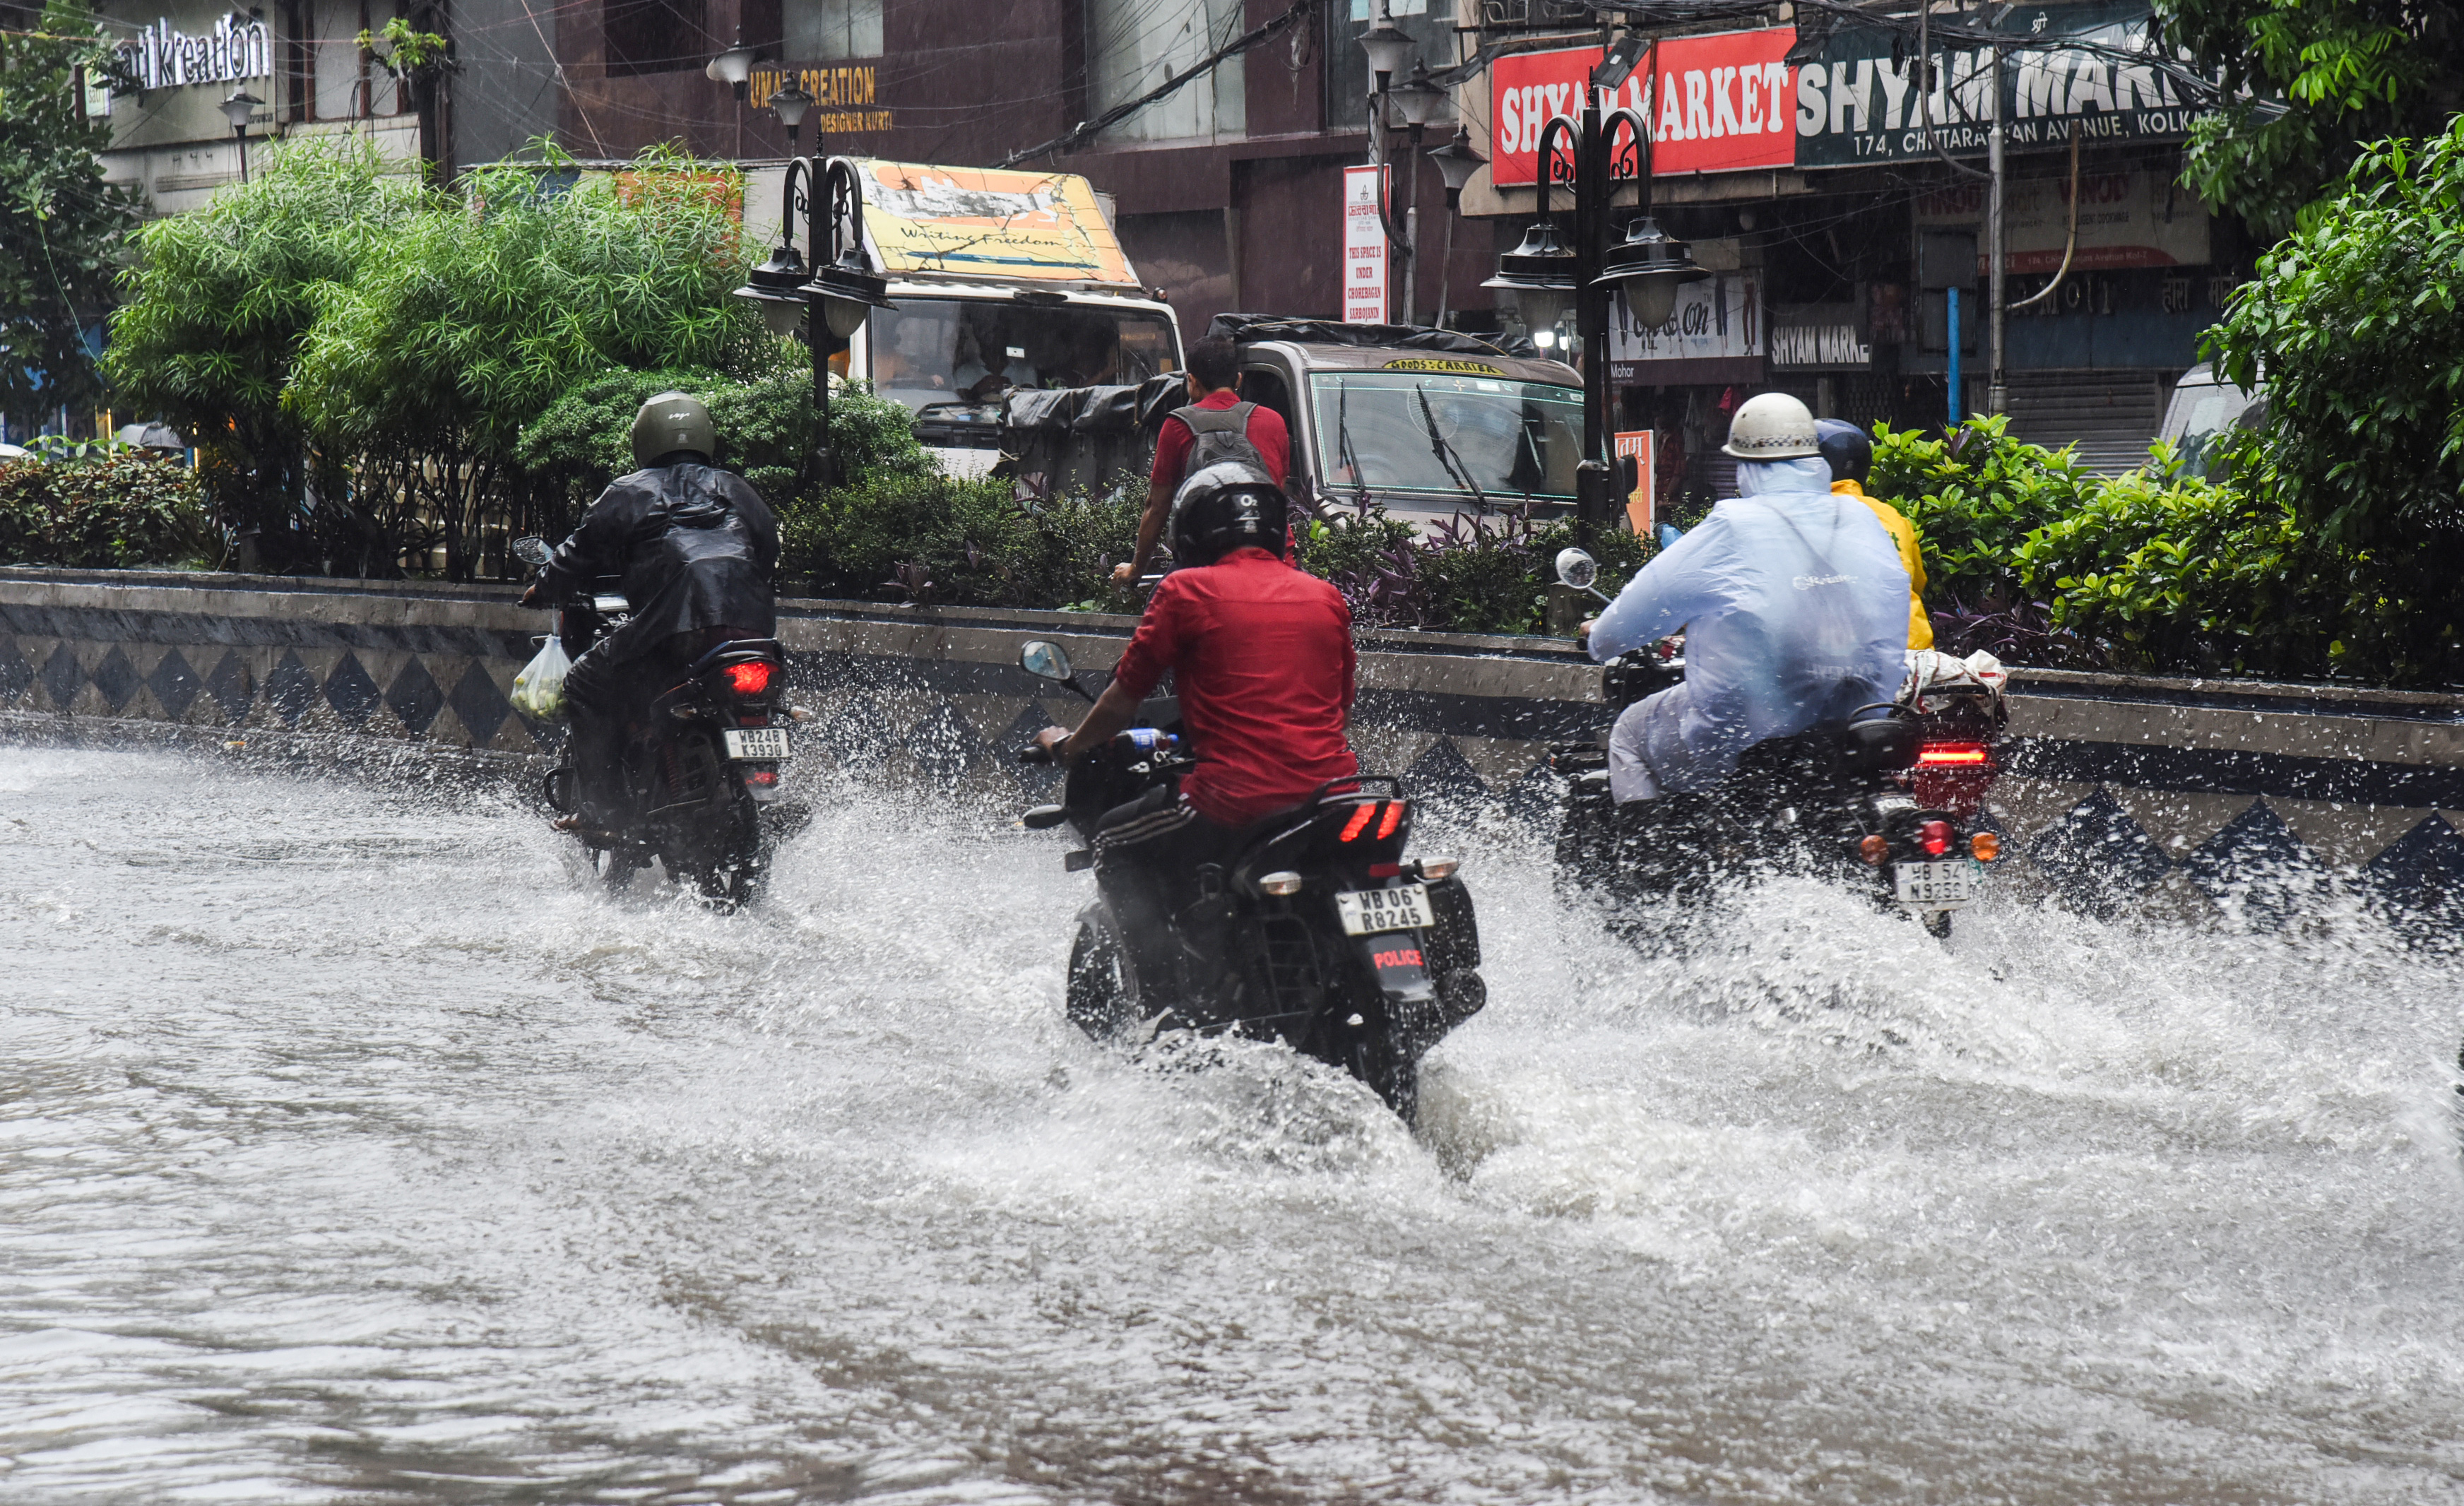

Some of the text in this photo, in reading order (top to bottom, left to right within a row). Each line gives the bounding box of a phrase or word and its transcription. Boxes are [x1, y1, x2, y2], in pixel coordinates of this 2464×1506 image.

[800, 66, 875, 106] CREATION
[1628, 61, 1789, 144] MARKET
[820, 112, 863, 133] DESIGNER
[1854, 134, 1893, 157] 174,
[2047, 116, 2129, 141] AVNUE,
[2057, 174, 2129, 204] VNOD
[901, 227, 976, 244] Writing
[1349, 246, 1382, 259] THIS SPACE IS
[1356, 267, 1373, 279] UNDER
[1348, 287, 1381, 300] CHOREBAGAN
[1349, 307, 1380, 322] SARBOJANIN
[1772, 326, 1817, 364] SHYAM
[1359, 889, 1412, 911] WB 06
[1361, 907, 1422, 931] R8245
[1373, 949, 1423, 970] POLICE
